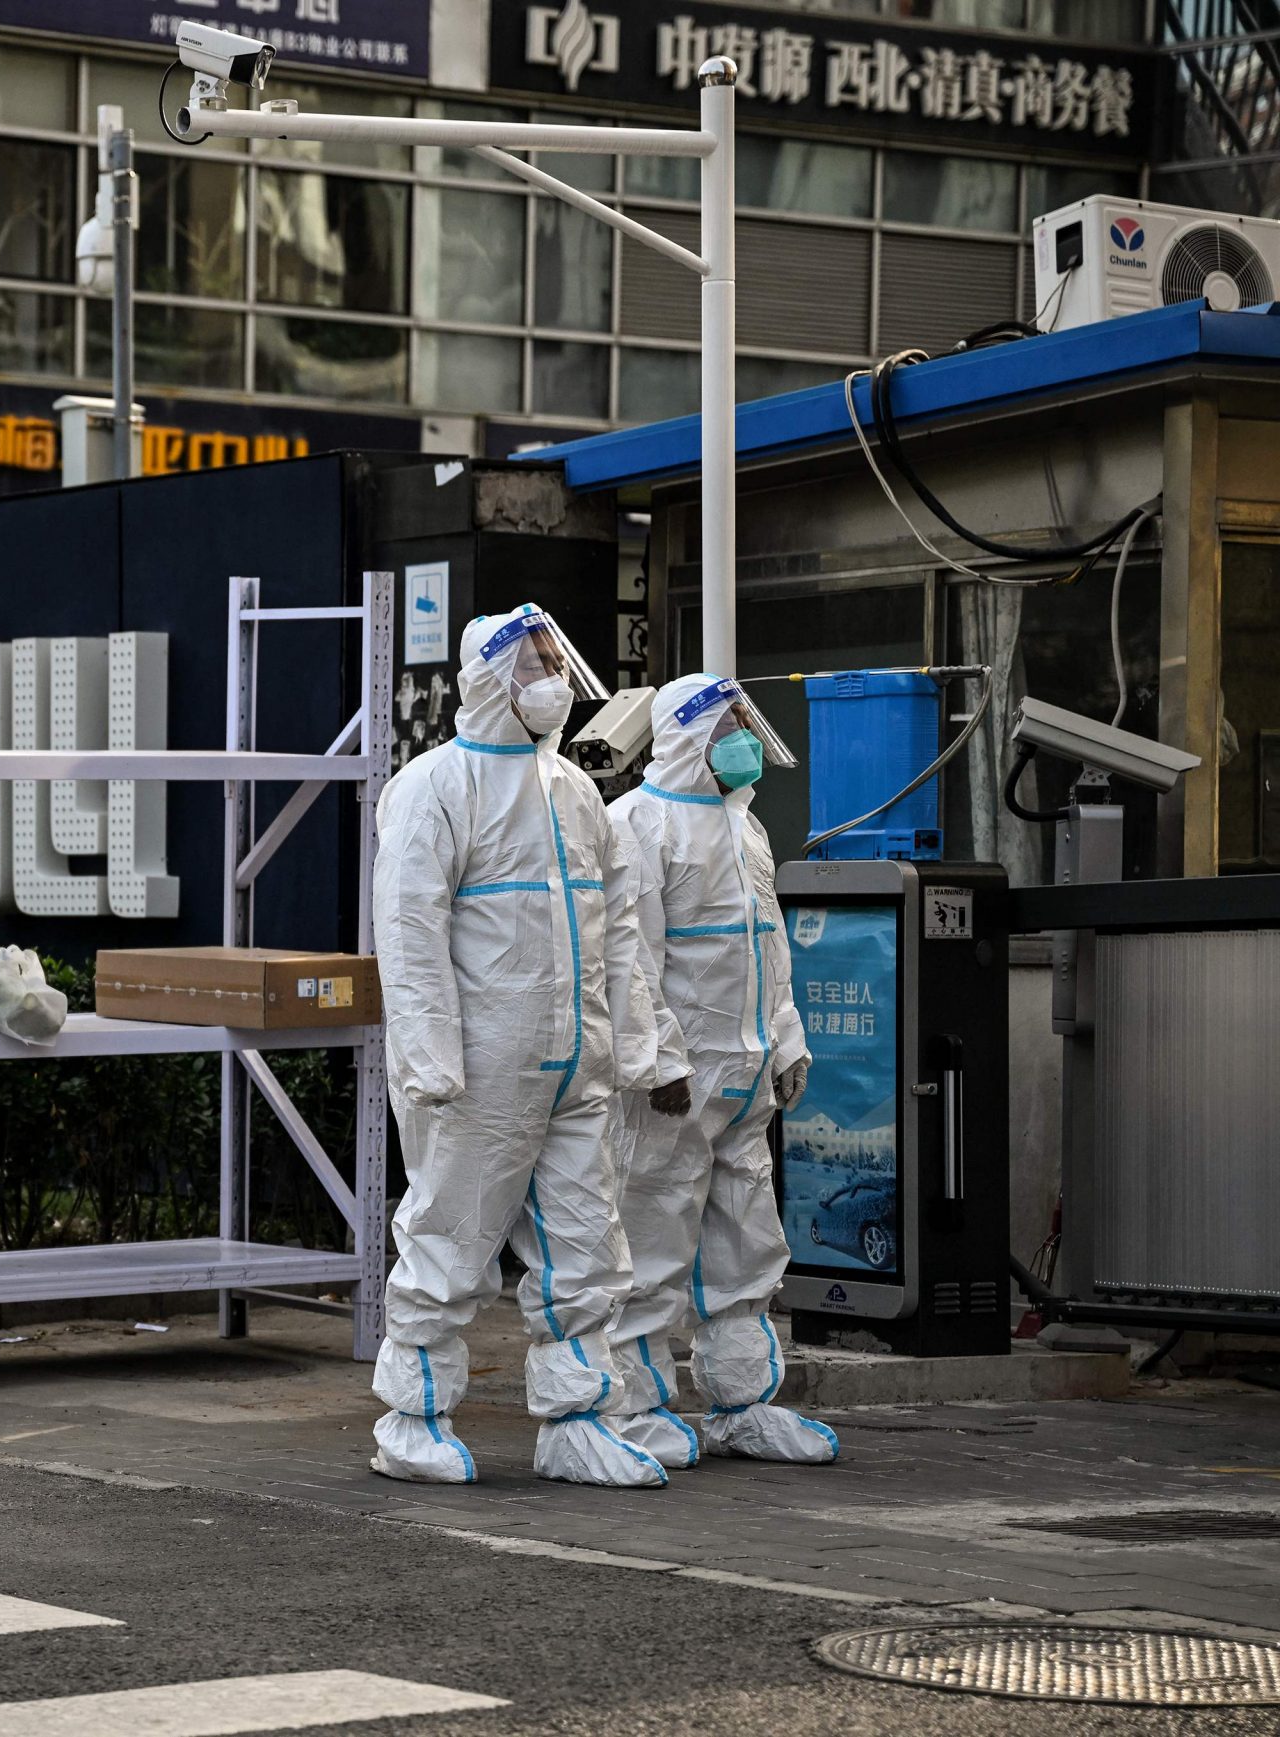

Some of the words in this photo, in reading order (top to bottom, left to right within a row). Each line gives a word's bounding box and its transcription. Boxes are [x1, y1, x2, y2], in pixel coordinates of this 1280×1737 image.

[1109, 254, 1148, 270] Chunlan
[933, 888, 964, 896] WARNING
[807, 1011, 875, 1036] 快捷通行
